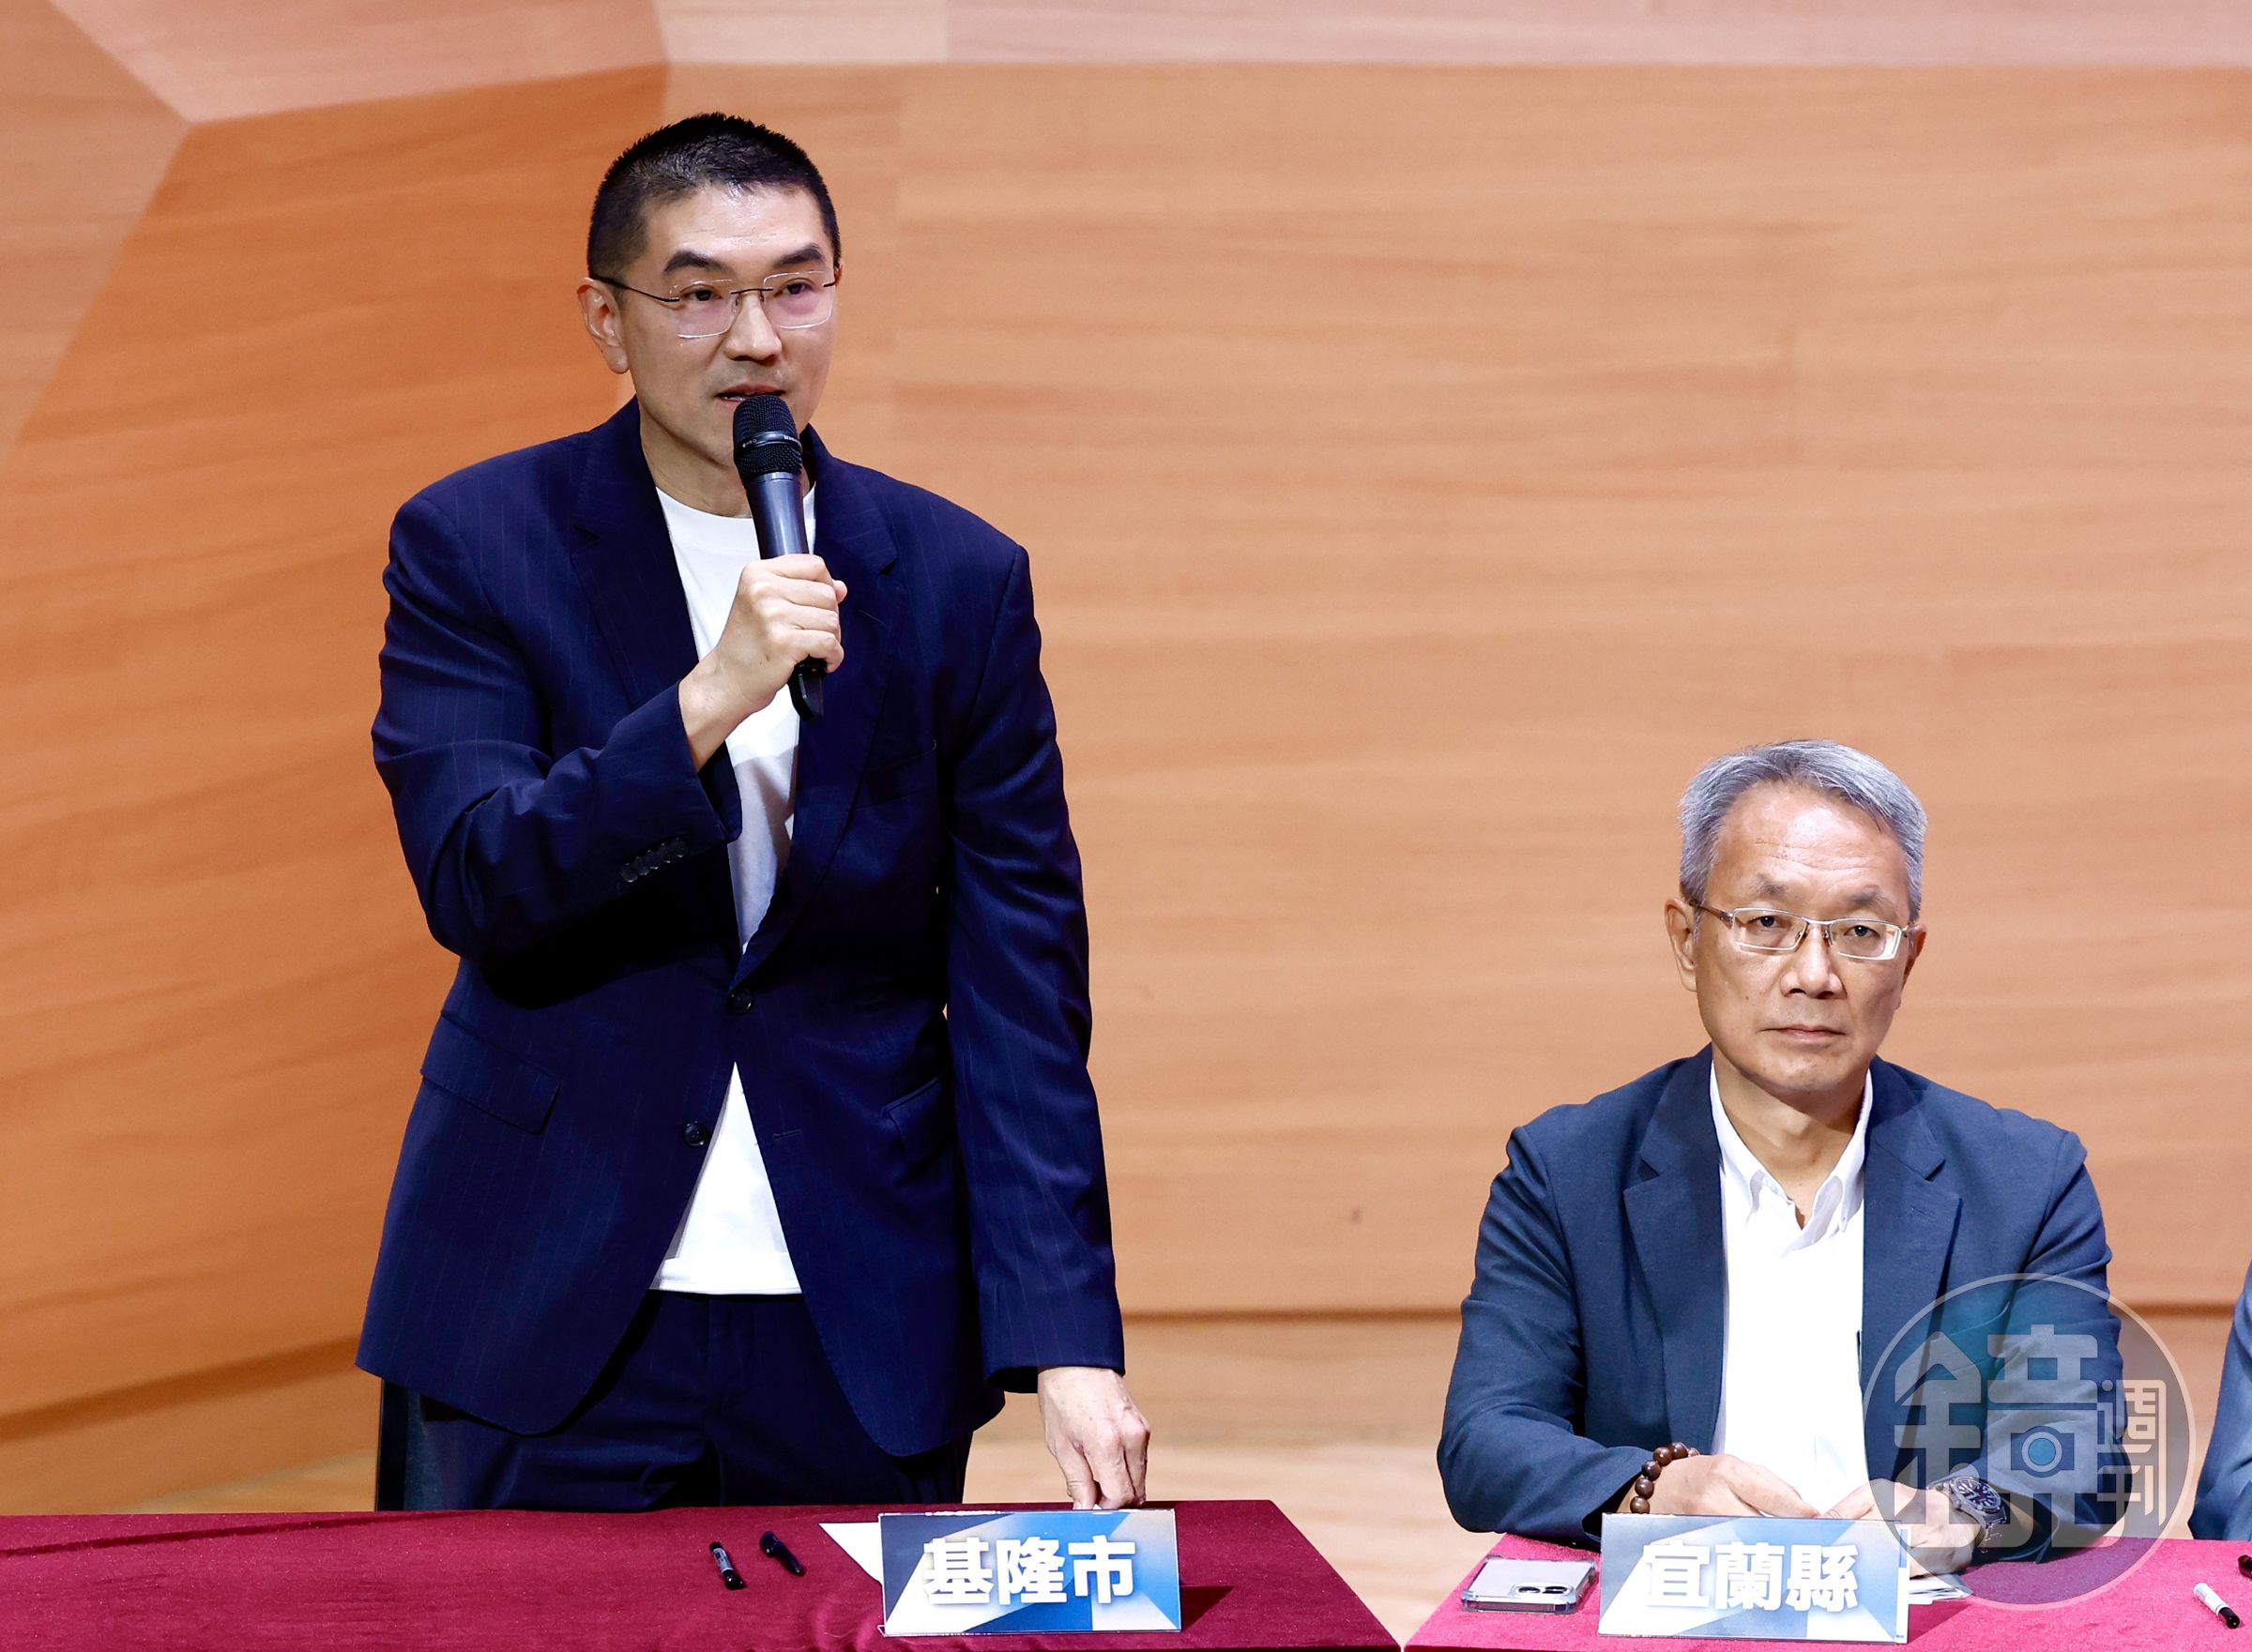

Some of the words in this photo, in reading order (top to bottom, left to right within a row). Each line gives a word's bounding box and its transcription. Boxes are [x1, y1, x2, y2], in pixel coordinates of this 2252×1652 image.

[922, 1534, 1136, 1606] 基隆市
[1641, 1540, 1860, 1613] 宜蘭縣
